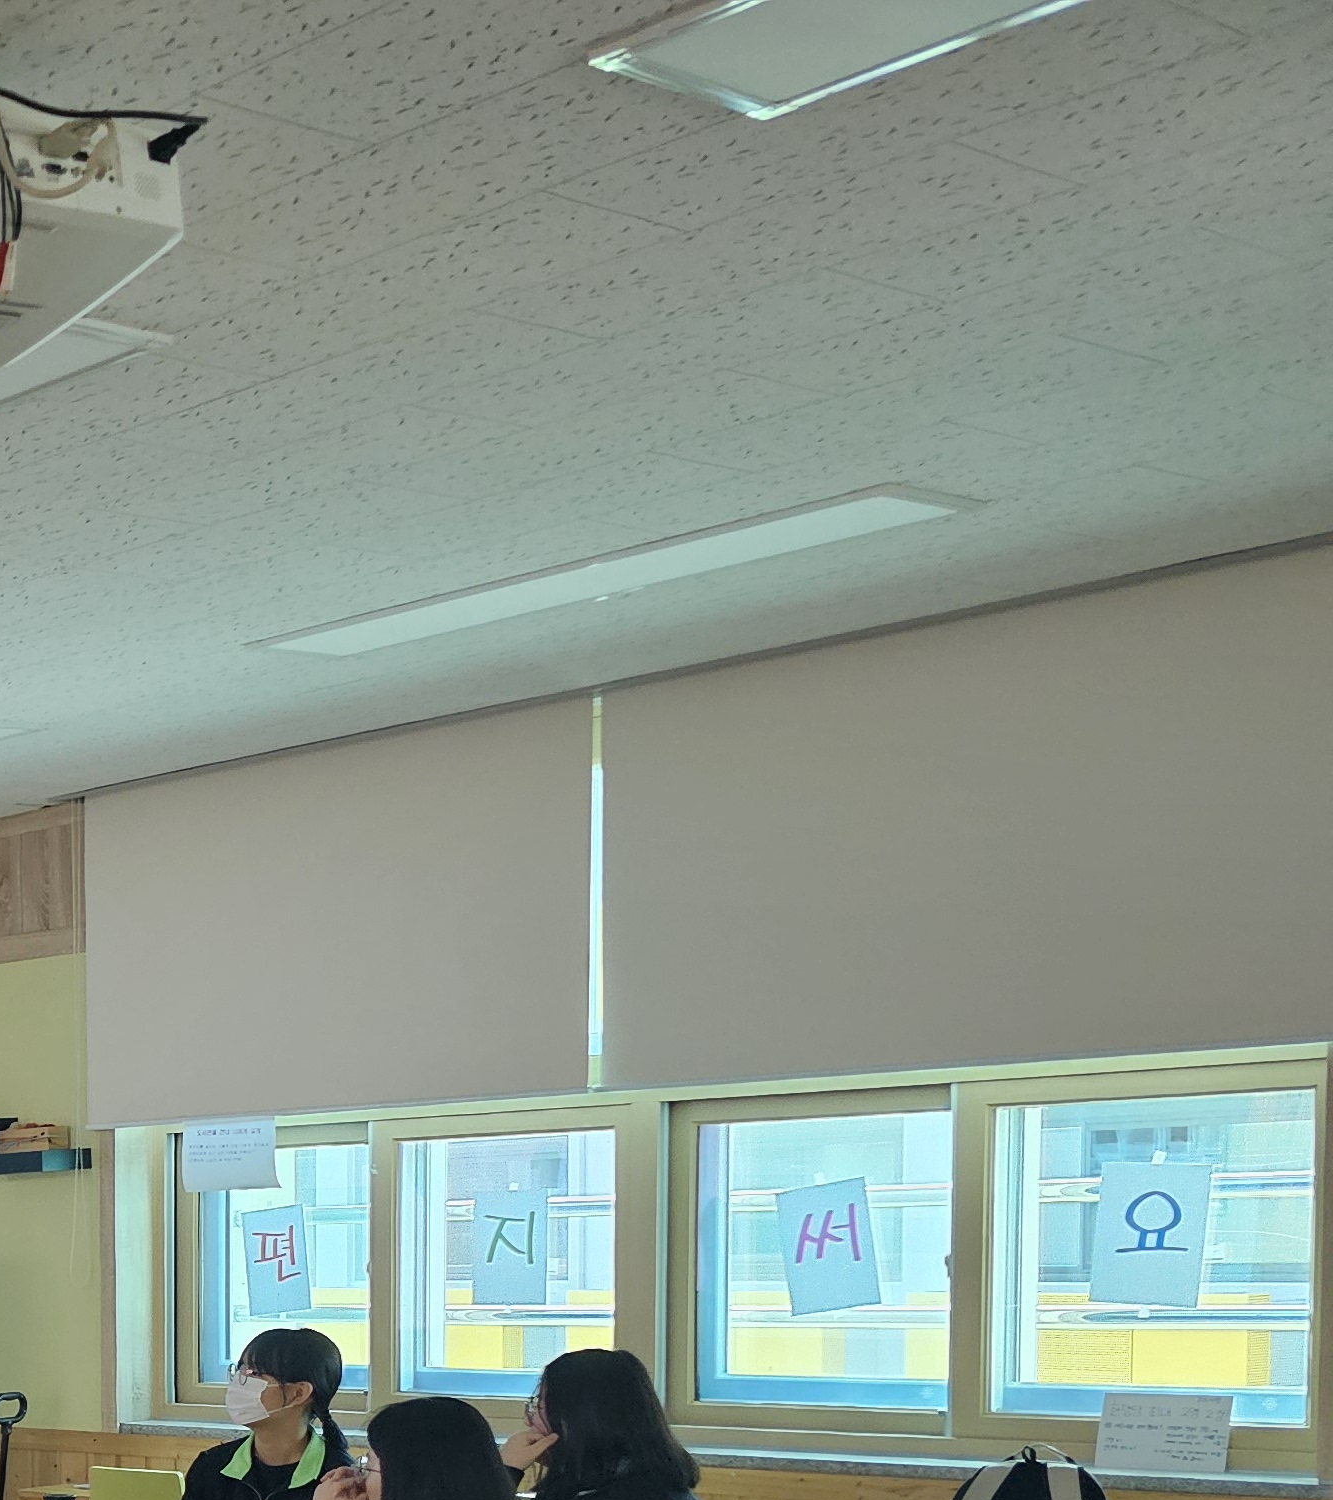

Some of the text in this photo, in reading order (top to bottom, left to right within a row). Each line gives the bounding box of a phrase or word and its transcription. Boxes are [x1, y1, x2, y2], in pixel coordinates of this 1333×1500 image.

[254, 1191, 1190, 1282] 편 지 써 요
